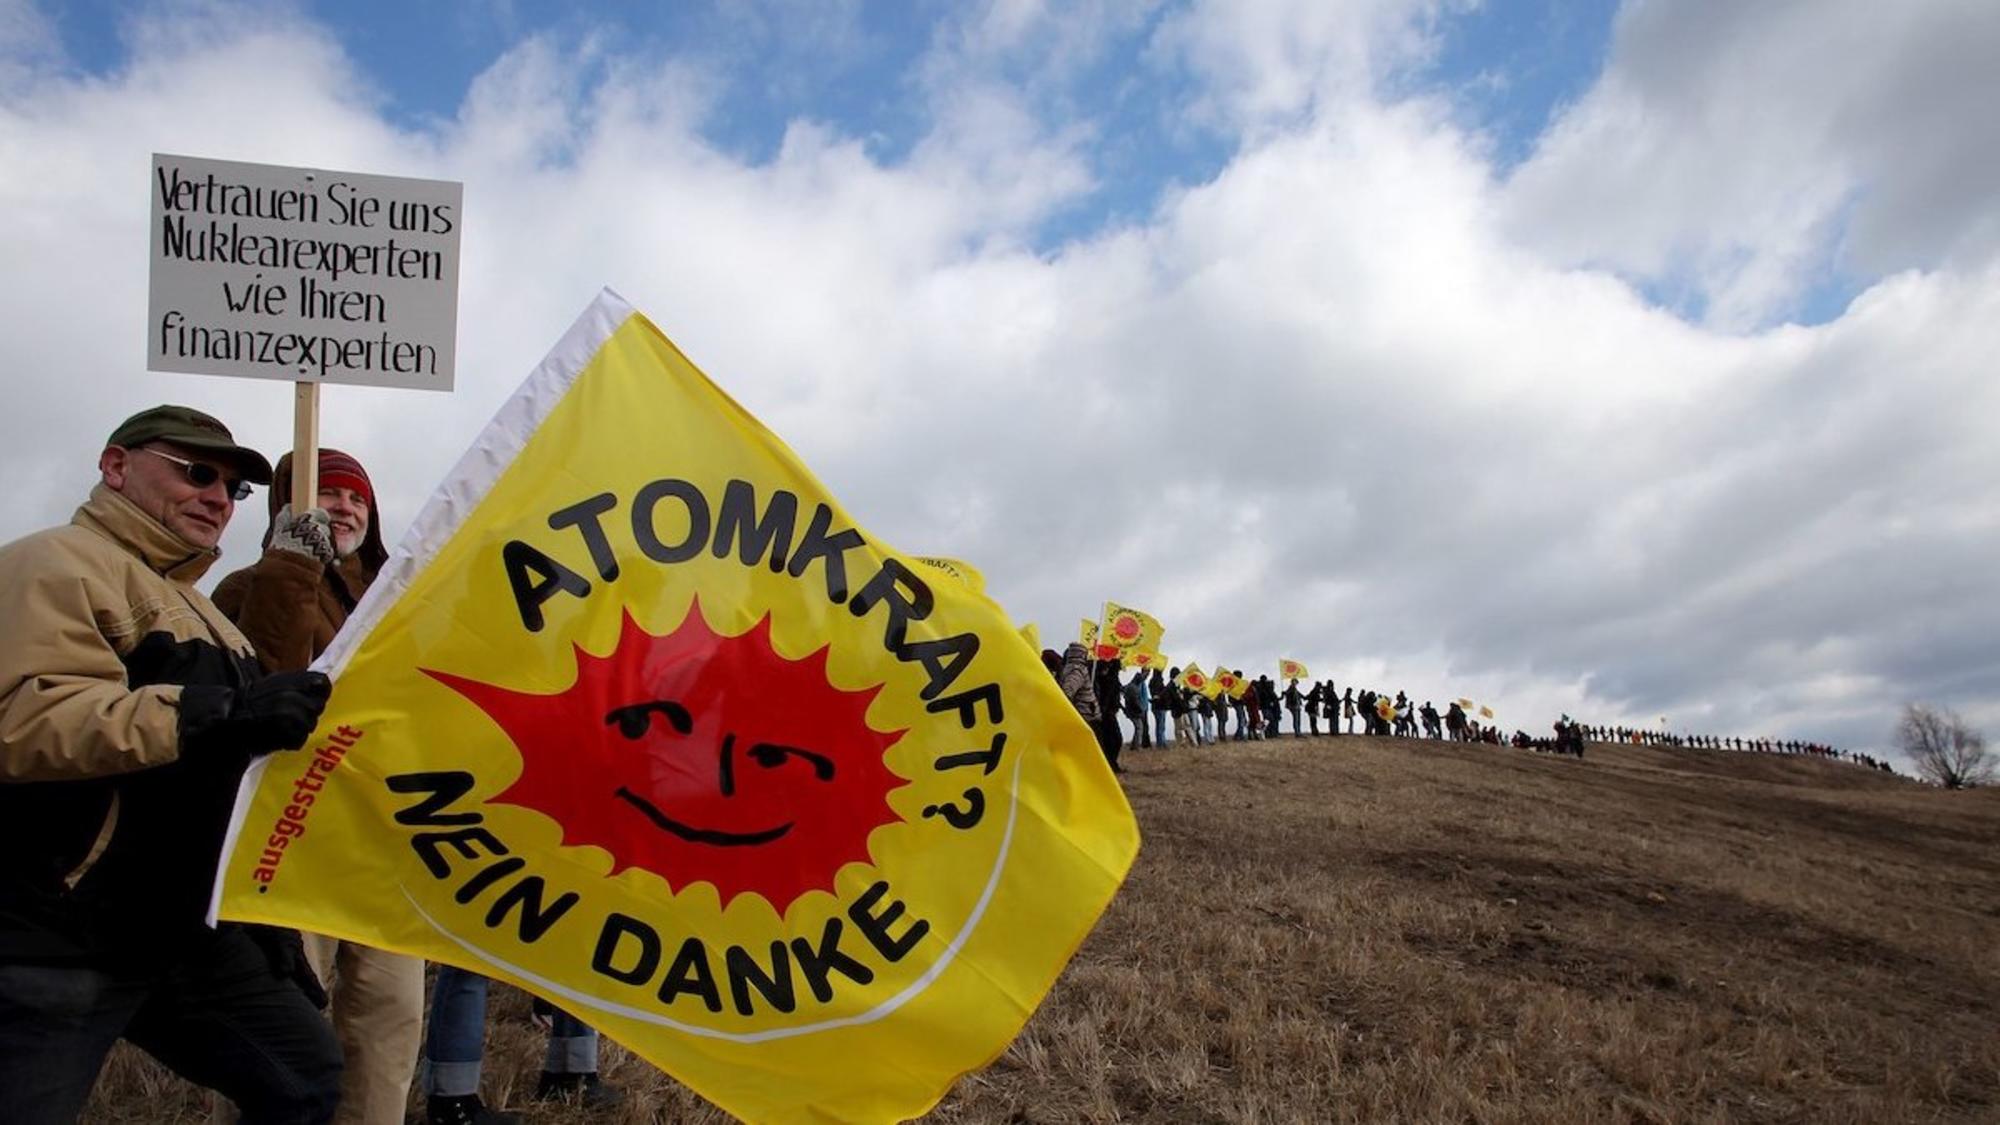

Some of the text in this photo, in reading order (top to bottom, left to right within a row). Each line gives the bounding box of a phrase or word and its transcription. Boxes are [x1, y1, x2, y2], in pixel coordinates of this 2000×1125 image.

[157, 165, 453, 235] Vertrauen Sie uns
[162, 214, 442, 281] Nuklearexperten
[300, 275, 386, 323] Ihren
[503, 479, 1007, 830] ATOMKRAFT?
[385, 770, 930, 1017] NEIN DANKE
